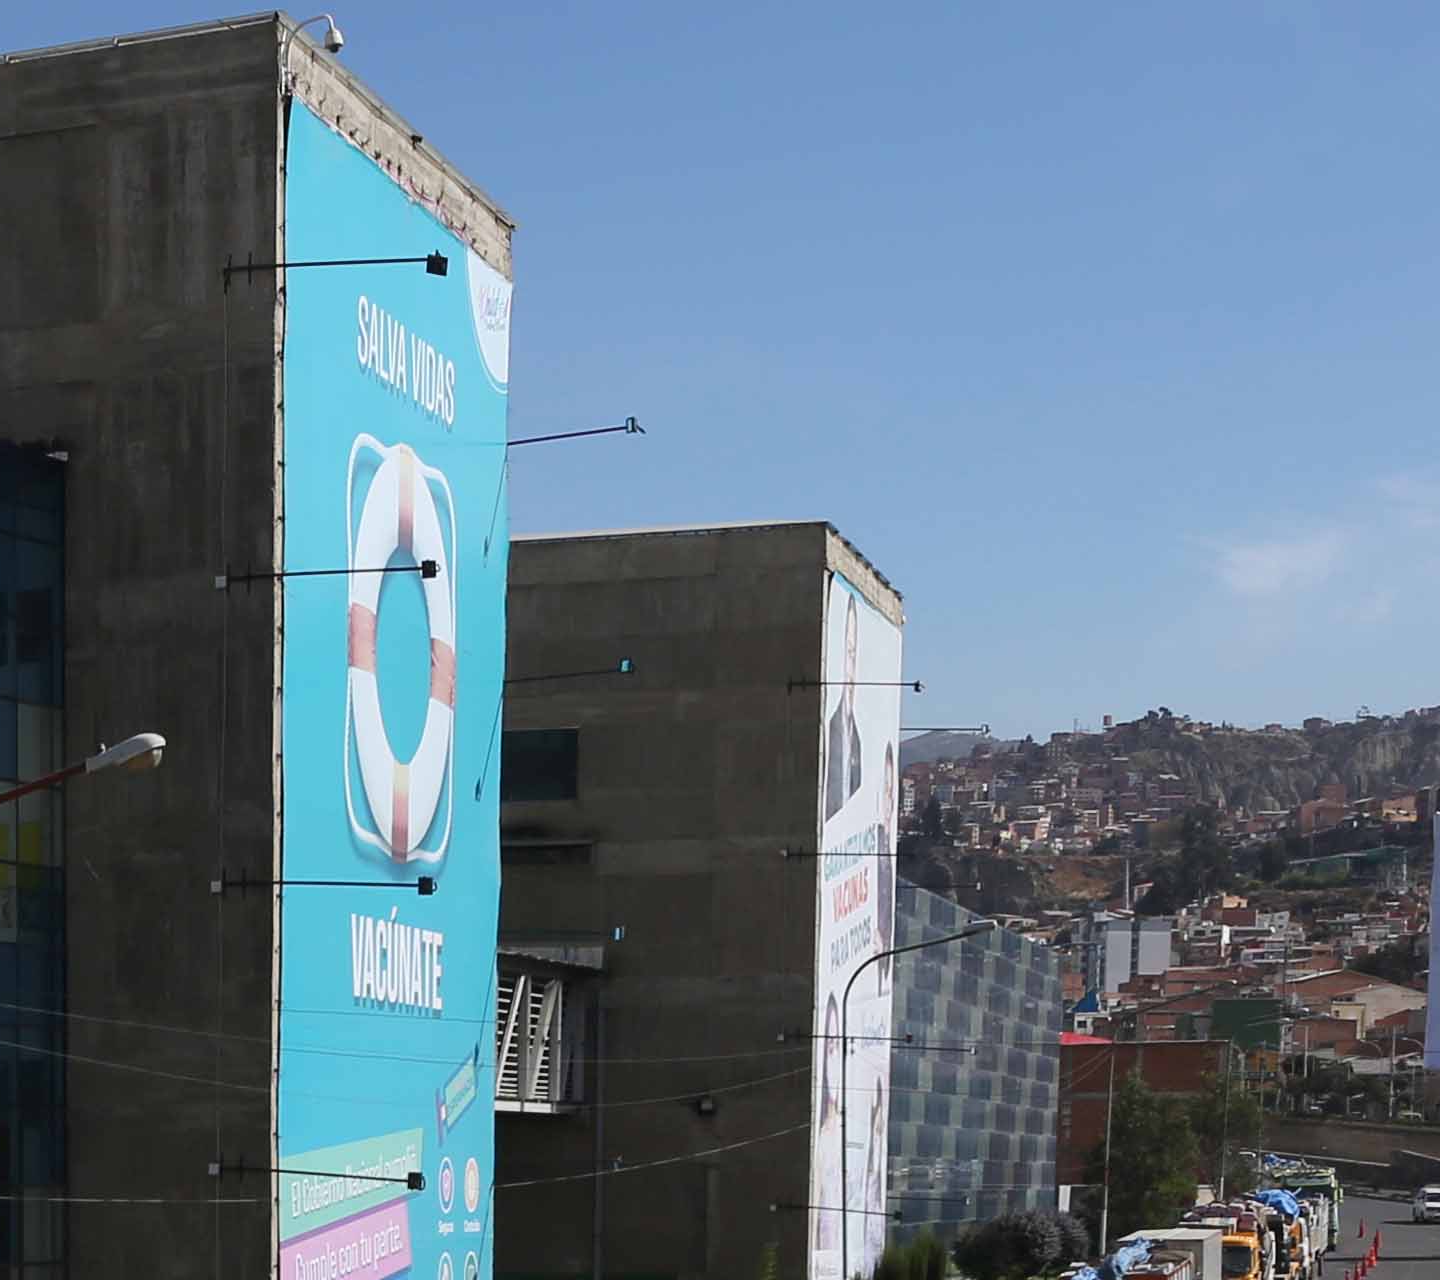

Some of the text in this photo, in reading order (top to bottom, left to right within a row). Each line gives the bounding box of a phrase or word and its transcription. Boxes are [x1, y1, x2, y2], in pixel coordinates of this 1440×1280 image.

[357, 295, 407, 394] SALVA
[411, 332, 454, 425] VIDAS
[351, 905, 443, 1010] VACÚNATE
[303, 1172, 344, 1212] Gobierno
[345, 1157, 383, 1198] Nacional
[338, 1243, 358, 1274] con
[360, 1232, 372, 1264] tu
[373, 1220, 403, 1268] parte.
